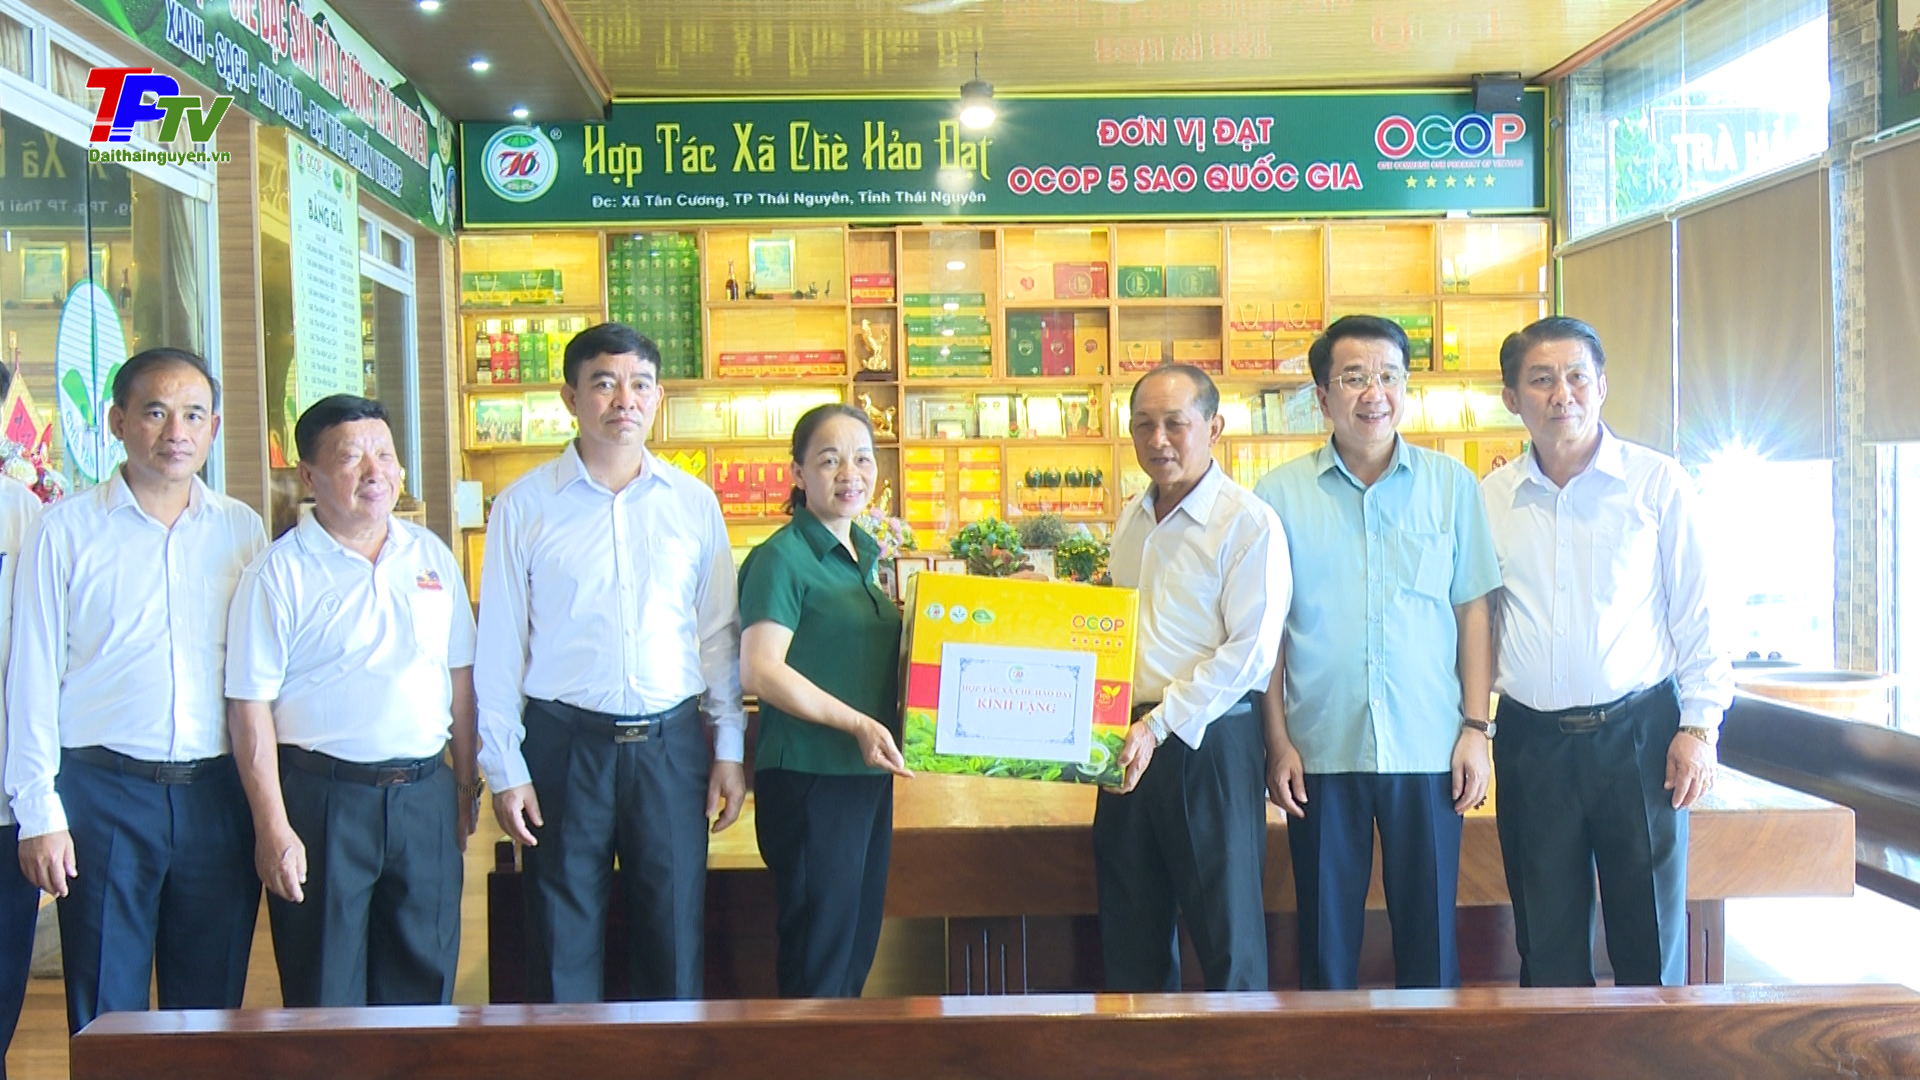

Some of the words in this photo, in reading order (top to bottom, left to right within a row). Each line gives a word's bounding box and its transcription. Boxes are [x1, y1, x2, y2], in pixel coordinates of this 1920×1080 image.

[166, 0, 205, 65] XANH
[215, 32, 249, 94] SẠCH
[258, 62, 276, 111] AN
[275, 75, 303, 130] TOÀN
[395, 96, 428, 170] NGUYÊN
[583, 125, 643, 188] Hợp
[655, 123, 717, 174] Tác
[732, 122, 776, 173] Xã
[790, 121, 848, 172] Chè
[862, 121, 922, 171] Hảo
[934, 120, 993, 181] Đạt
[1097, 114, 1167, 147] ĐƠN
[1173, 117, 1206, 153] VỊ
[1213, 117, 1274, 152] ĐẠT
[1375, 113, 1526, 160] OCOP
[1671, 123, 1738, 171] TRÀ
[1007, 165, 1102, 195] OCOP
[1108, 165, 1129, 195] 5
[1134, 164, 1198, 193] SAO
[1204, 152, 1299, 193] QUỐC
[1305, 162, 1363, 192] GIA
[621, 194, 641, 208] Xã
[645, 193, 673, 207] Tân
[735, 192, 753, 206] TP
[757, 191, 790, 206] Thái
[793, 191, 854, 208] Nguyên,
[858, 189, 891, 205] Tỉnh
[895, 190, 927, 204] Thái
[931, 190, 987, 206] Nguyên
[1072, 615, 1125, 632] OCOP
[977, 697, 1013, 710] KÍNH
